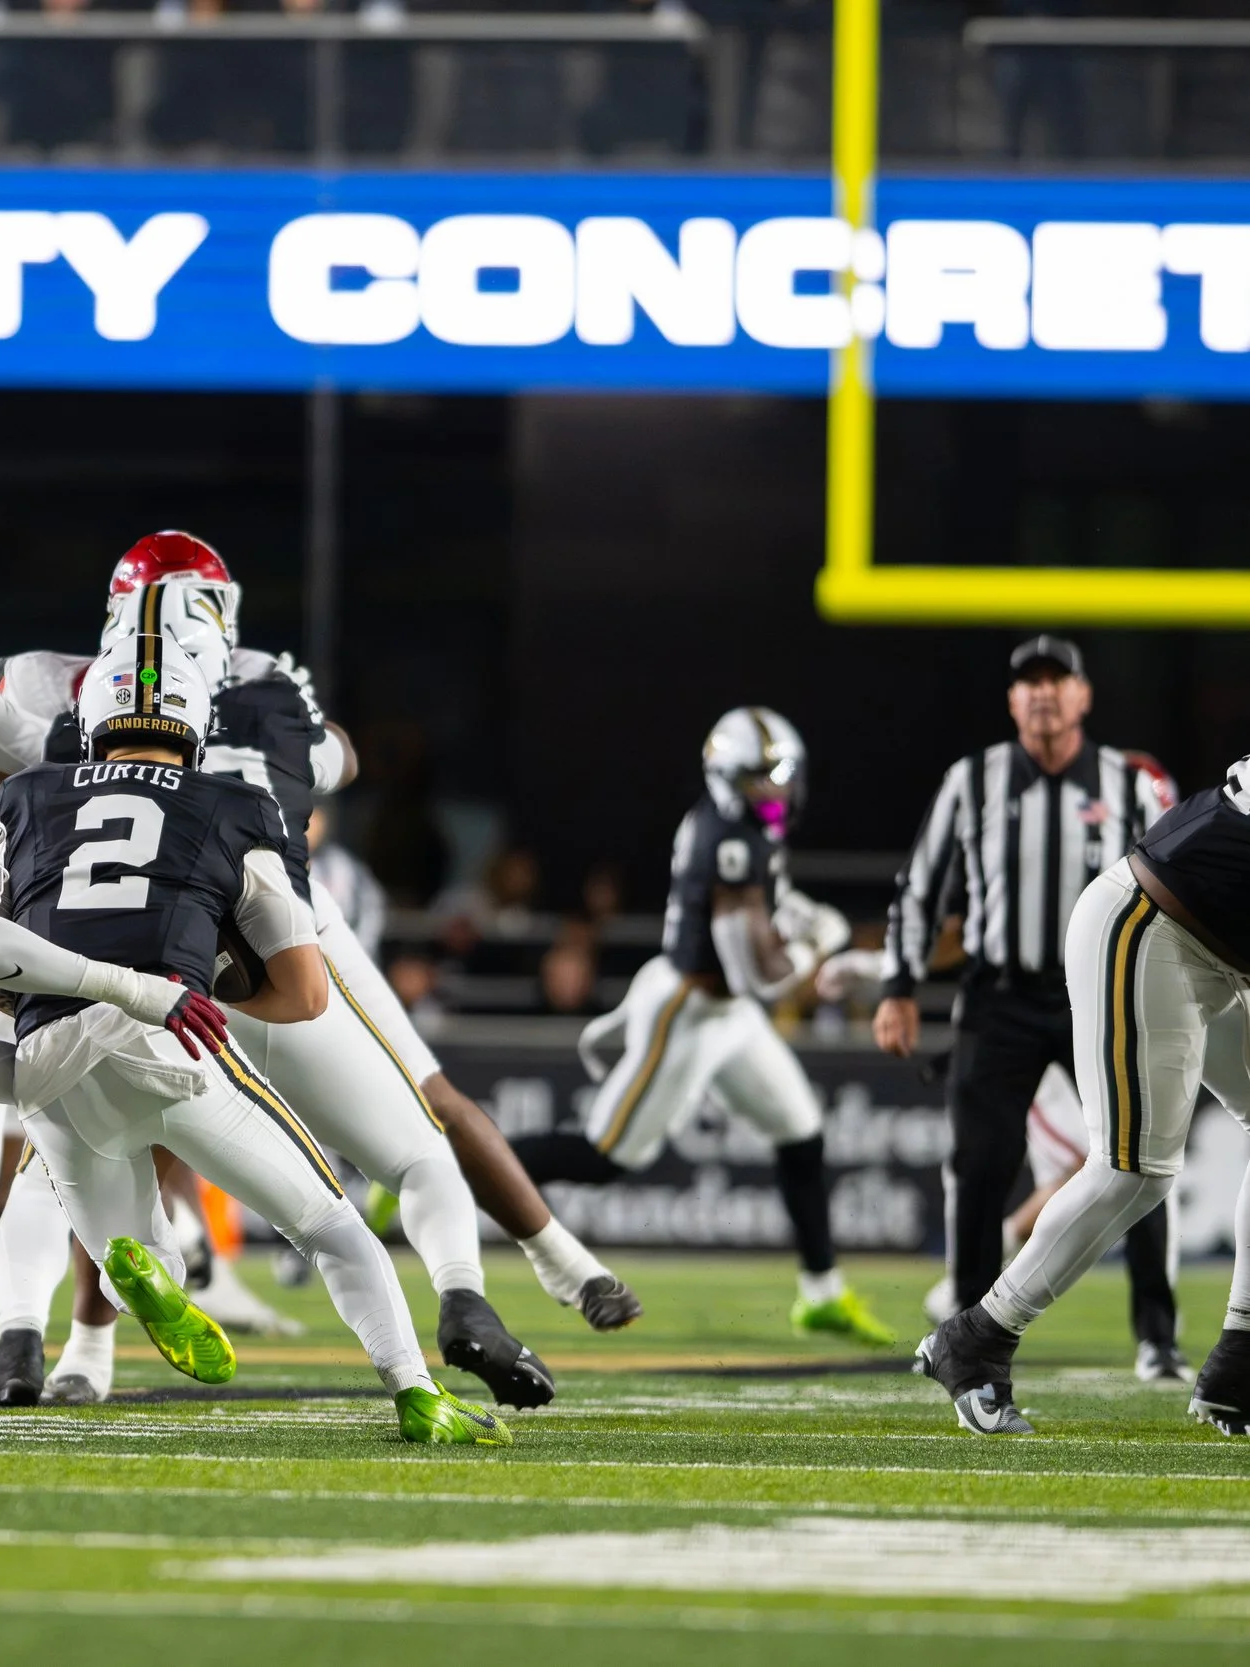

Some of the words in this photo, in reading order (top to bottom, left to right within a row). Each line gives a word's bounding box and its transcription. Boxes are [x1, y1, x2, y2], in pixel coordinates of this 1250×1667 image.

[116, 688, 131, 704] SEC
[153, 692, 161, 704] 2
[106, 717, 190, 737] VANDERBILT
[73, 763, 184, 791] CURTIS
[56, 793, 166, 910] 2
